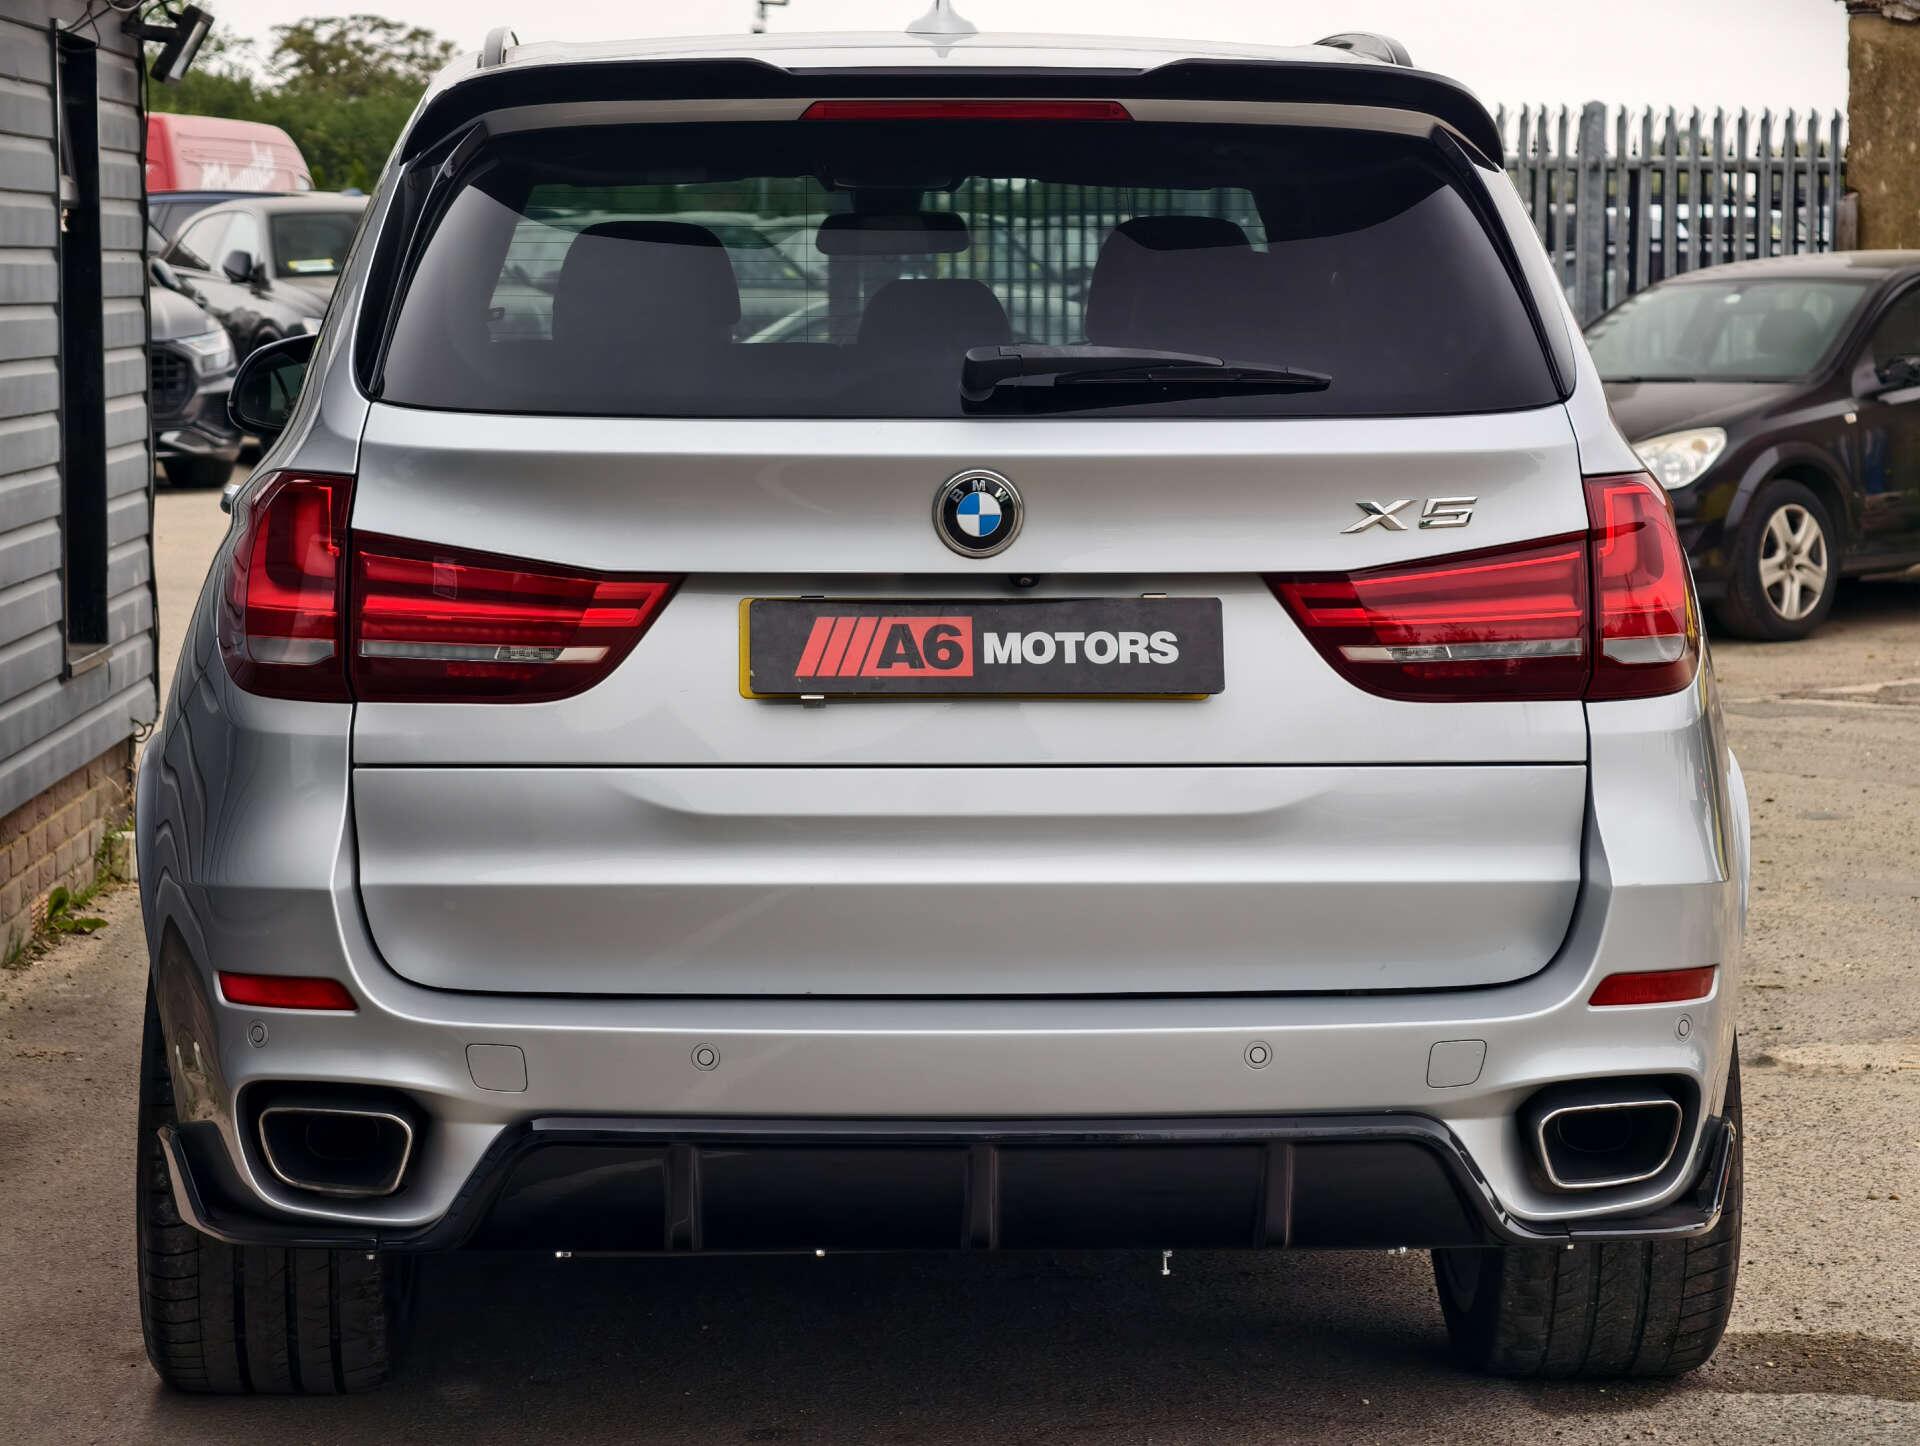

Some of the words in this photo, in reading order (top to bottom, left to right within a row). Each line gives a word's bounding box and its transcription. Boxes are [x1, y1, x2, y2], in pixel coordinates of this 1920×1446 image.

[949, 479, 1009, 503] BMW
[1338, 496, 1478, 533] X5
[983, 631, 1179, 665] MOTORS
